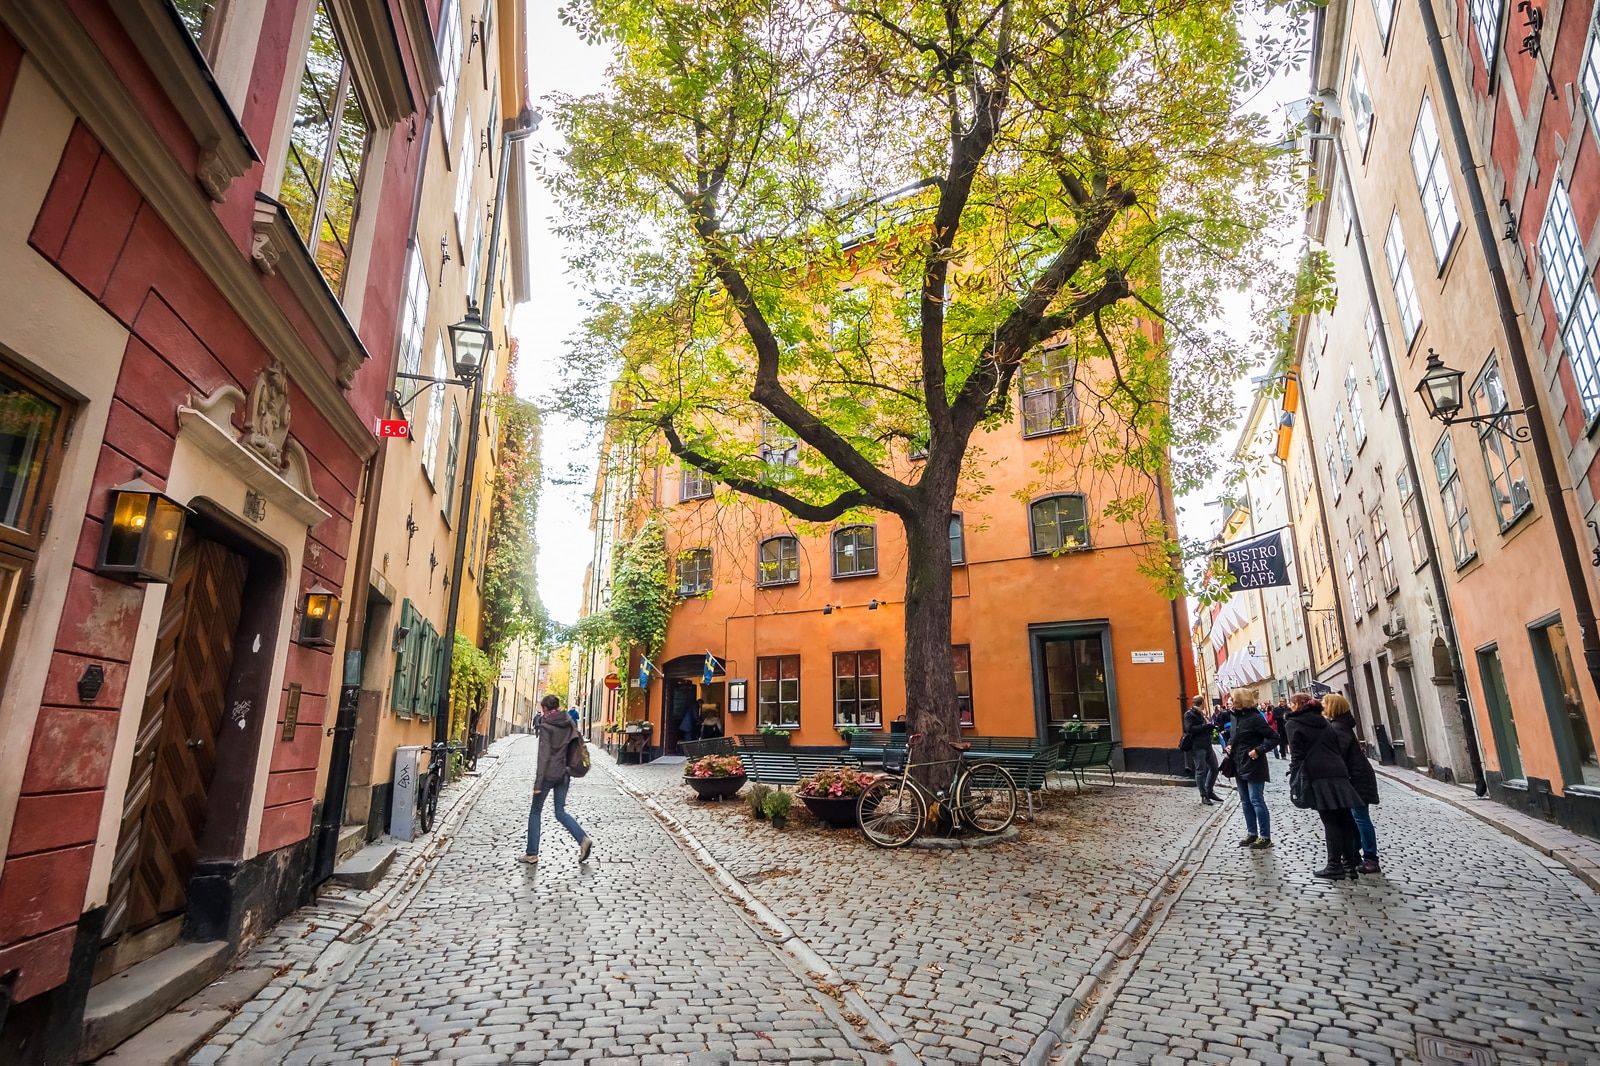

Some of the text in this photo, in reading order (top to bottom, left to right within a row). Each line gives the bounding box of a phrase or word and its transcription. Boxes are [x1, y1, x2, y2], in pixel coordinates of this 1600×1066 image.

[1228, 545, 1277, 563] BISTRO
[1241, 559, 1269, 574] BAR
[1239, 570, 1276, 588] CAFÉ
